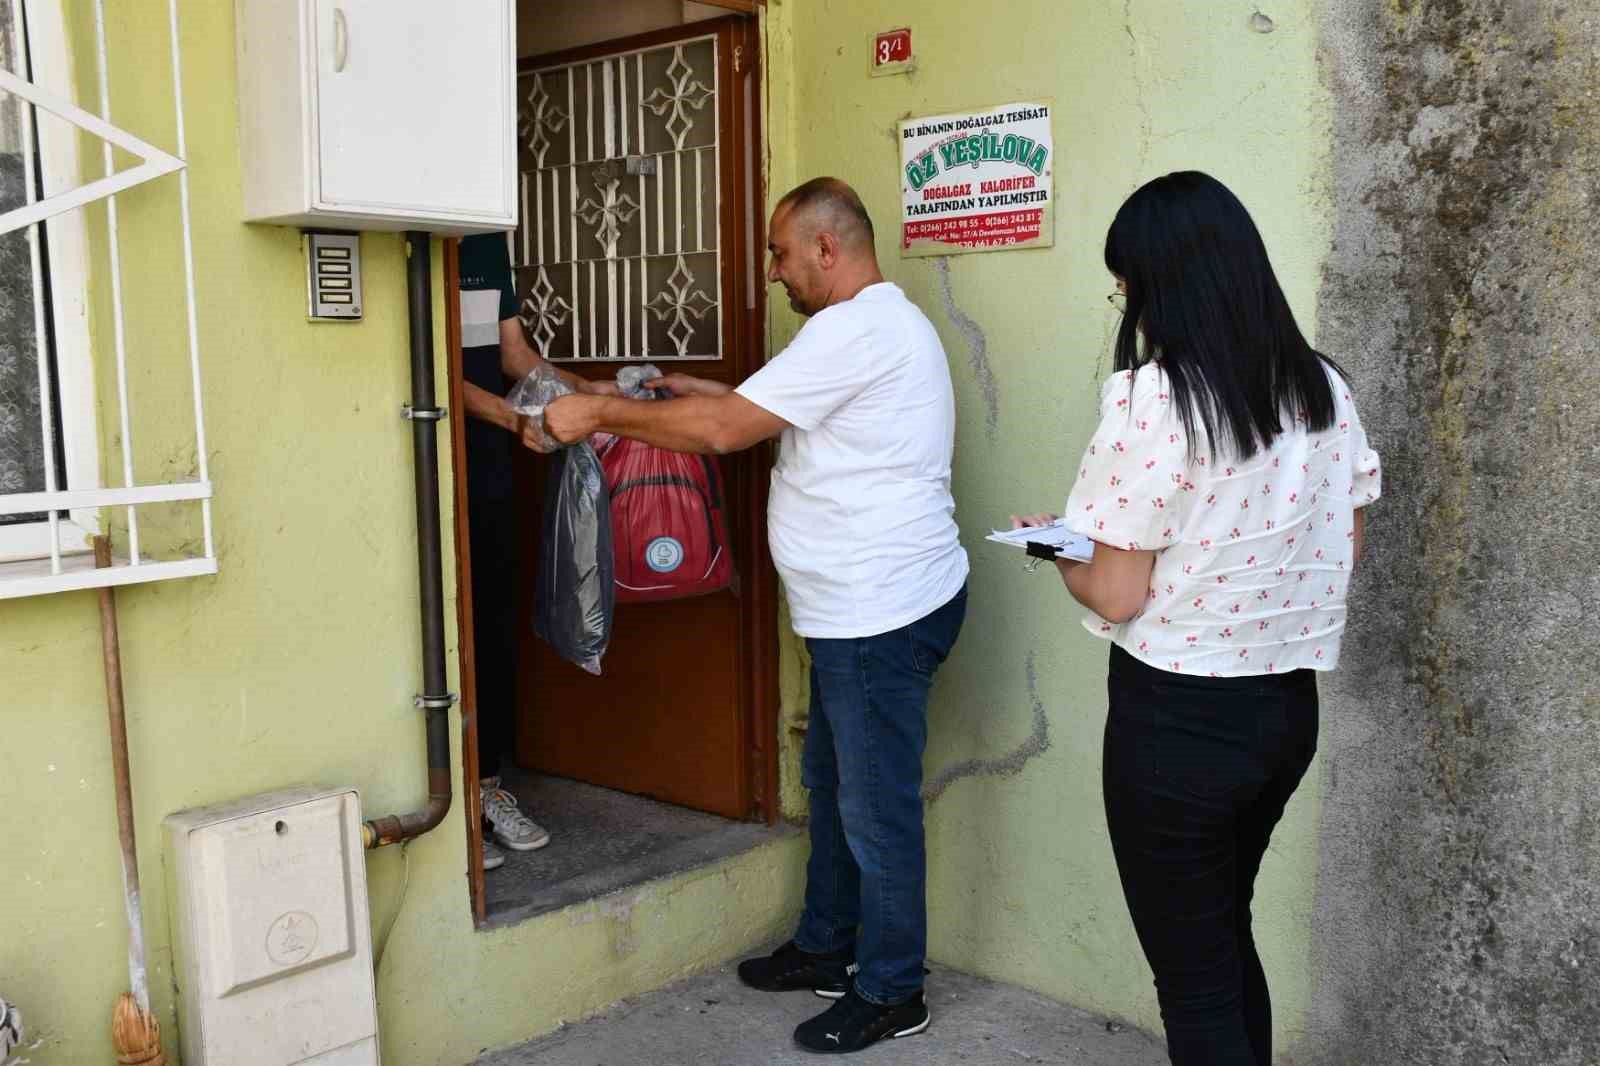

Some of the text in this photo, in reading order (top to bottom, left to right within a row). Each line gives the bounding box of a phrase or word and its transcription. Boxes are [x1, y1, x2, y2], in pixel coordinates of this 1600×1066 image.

[880, 36, 901, 63] 3/1
[903, 108, 1048, 138] BU BİNANIN DOĞALGAZ TESİSATI
[905, 150, 939, 191] ÖZ
[938, 128, 1048, 176] YEŞİLOVA
[923, 176, 1035, 200] DOĞALGAZ KALORİFER
[907, 190, 1048, 216] TARAFINDAN YAPILMIŞTIR
